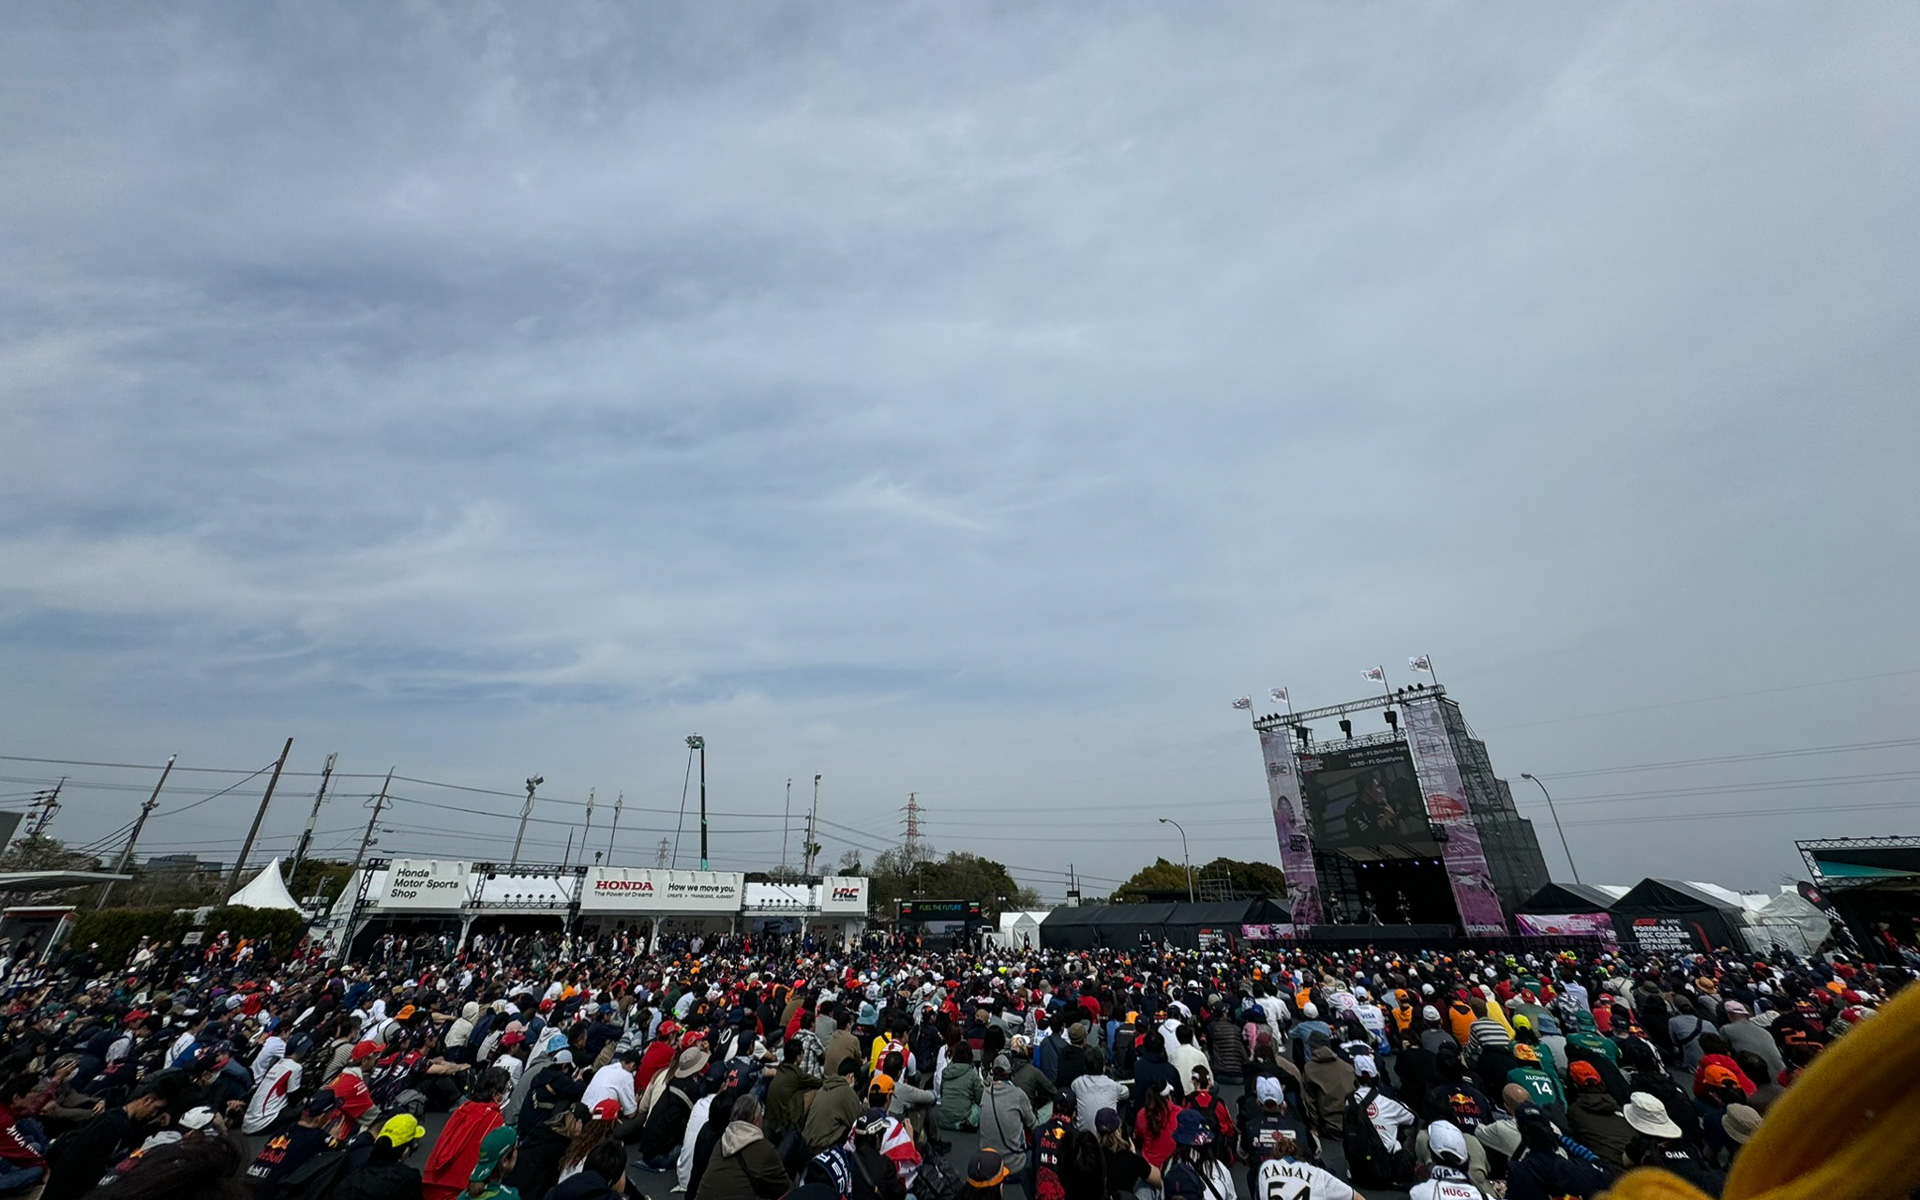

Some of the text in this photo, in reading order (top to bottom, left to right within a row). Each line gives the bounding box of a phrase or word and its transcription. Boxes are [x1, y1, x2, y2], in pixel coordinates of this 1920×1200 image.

[1376, 756, 1404, 764] Qualifying
[397, 868, 430, 877] Honda
[394, 879, 459, 889] Motor Sports
[594, 880, 654, 891] HONDA
[668, 882, 686, 891] How
[687, 884, 699, 892] we
[391, 889, 417, 899] Shop
[832, 887, 860, 898] HRC
[1532, 1081, 1553, 1096] 14
[1040, 1152, 1058, 1165] Mob
[1262, 1163, 1312, 1184] TAMAI
[1268, 1181, 1310, 1200] 54
[1442, 1187, 1471, 1197] HUGO
